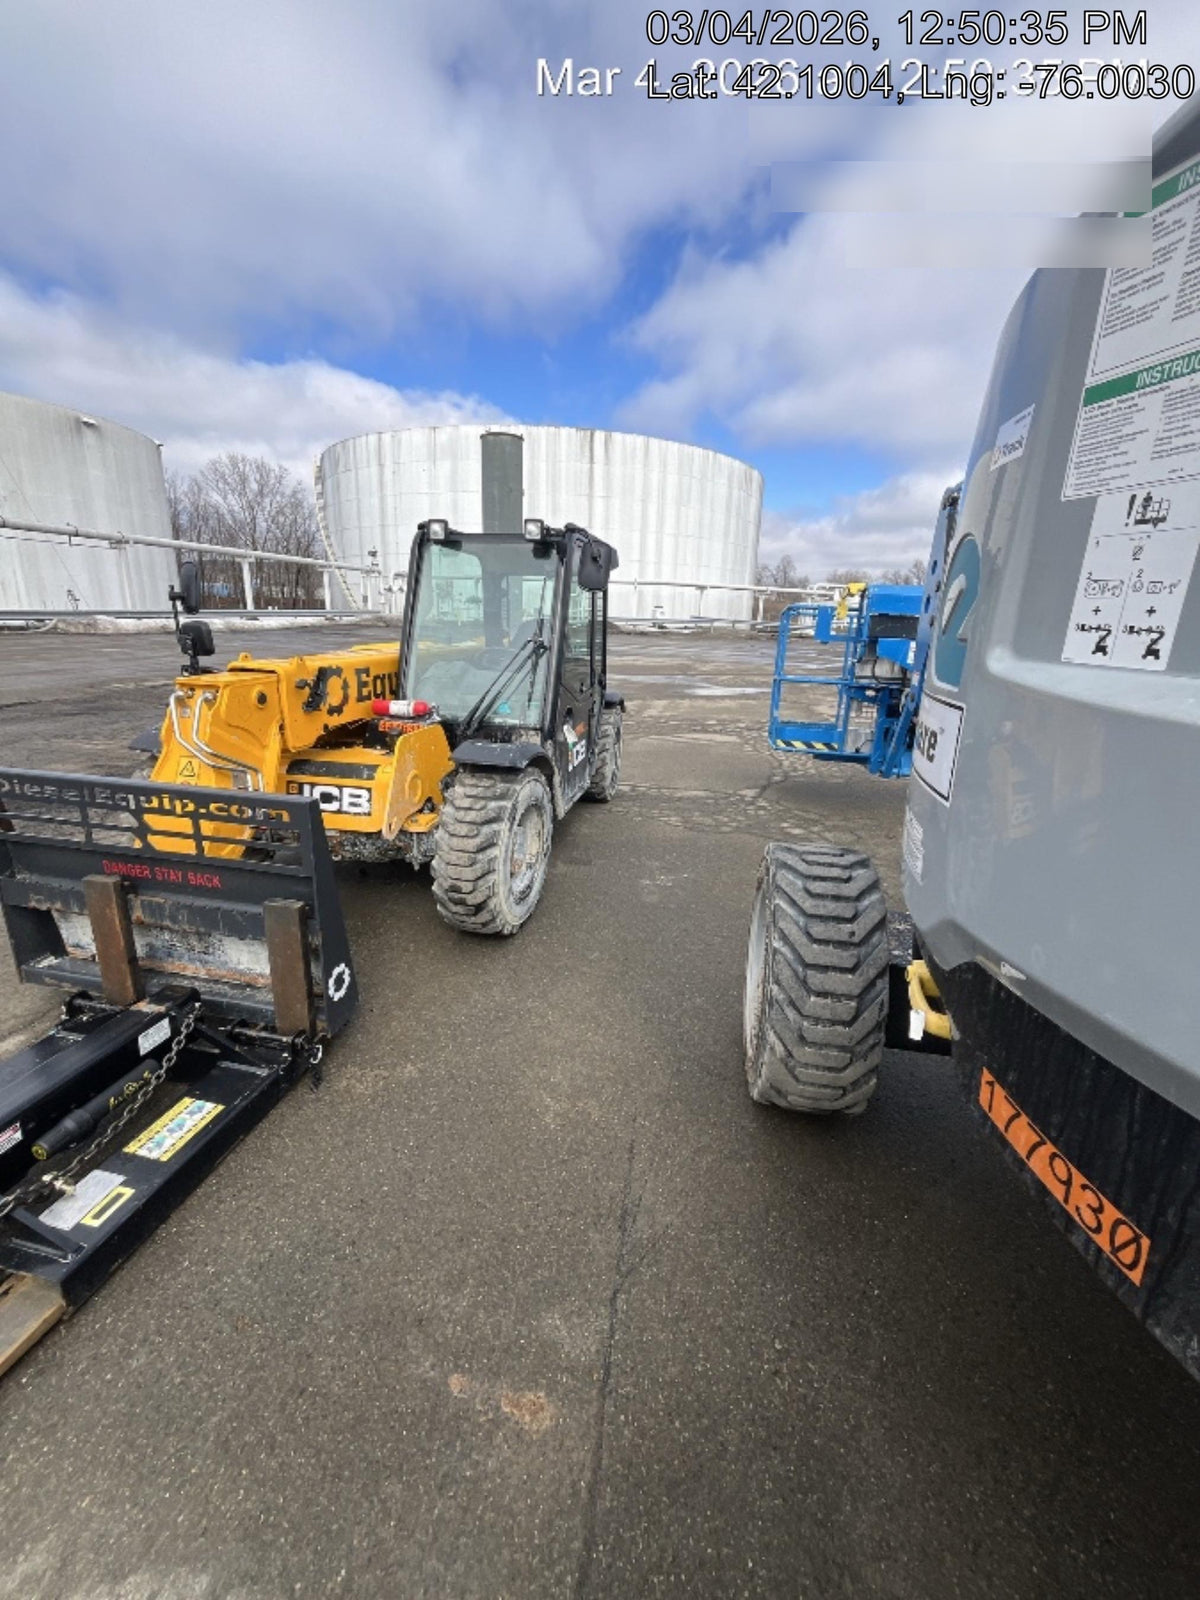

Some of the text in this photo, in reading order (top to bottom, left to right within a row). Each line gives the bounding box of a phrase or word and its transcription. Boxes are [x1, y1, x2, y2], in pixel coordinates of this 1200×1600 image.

[101, 859, 222, 889] DANGER STAY BACK
[984, 1080, 1143, 1272] 177930
